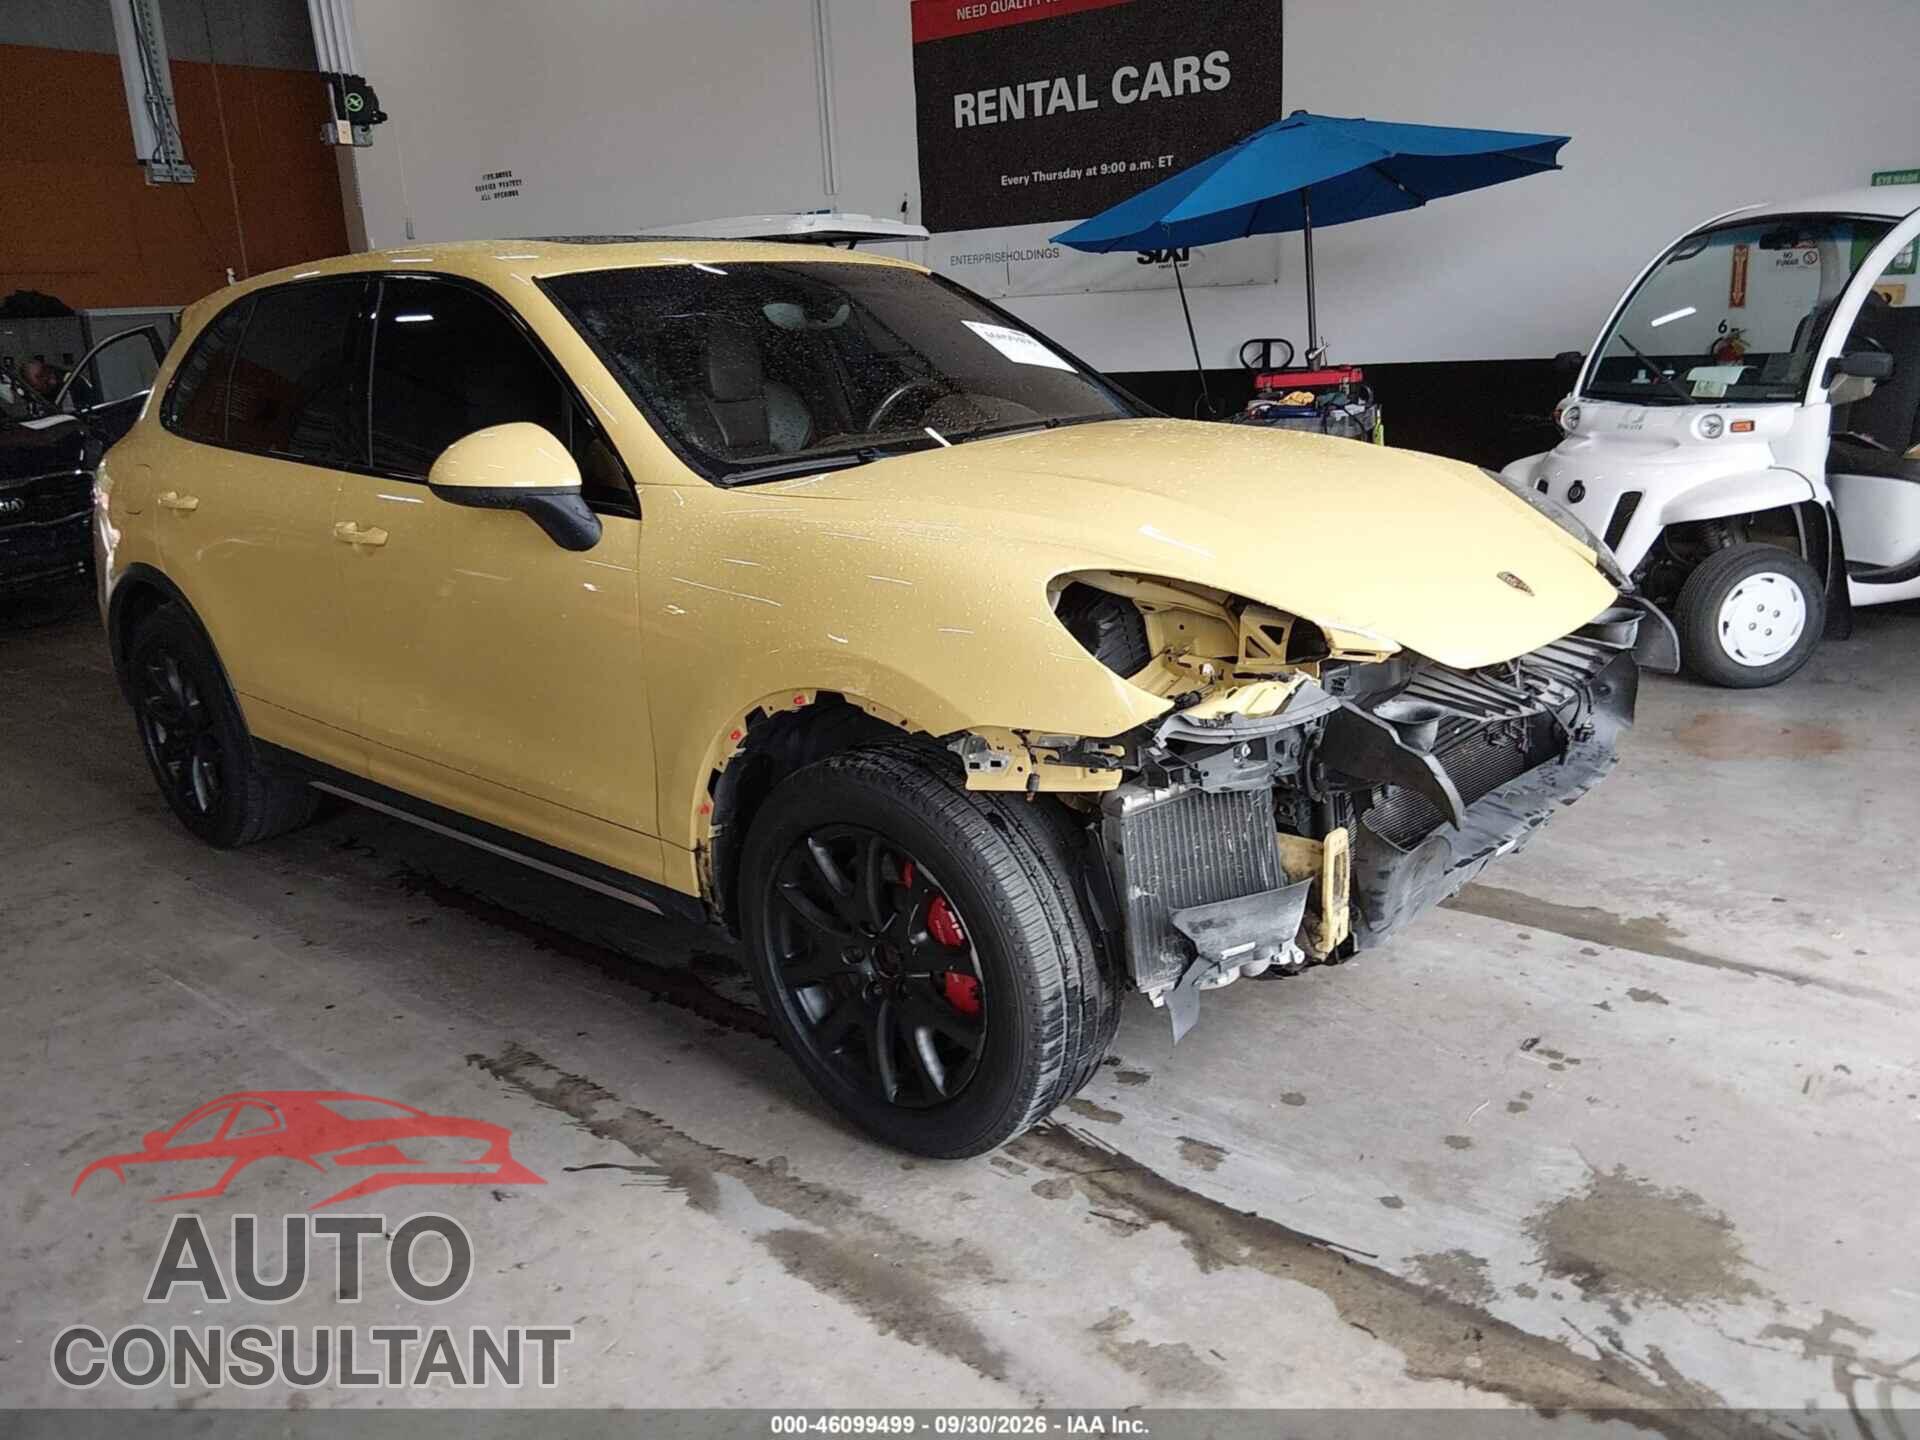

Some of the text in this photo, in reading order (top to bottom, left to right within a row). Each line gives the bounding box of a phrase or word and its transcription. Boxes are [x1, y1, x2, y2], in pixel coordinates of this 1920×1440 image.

[956, 3, 987, 21] NEED
[953, 50, 1232, 129] RENTAL CARS
[1001, 154, 1174, 187] Every Thursday at 9:00 a.m. ET
[950, 247, 1060, 266] ENTERPRISEHOLDINGS
[1718, 319, 1728, 334] 6
